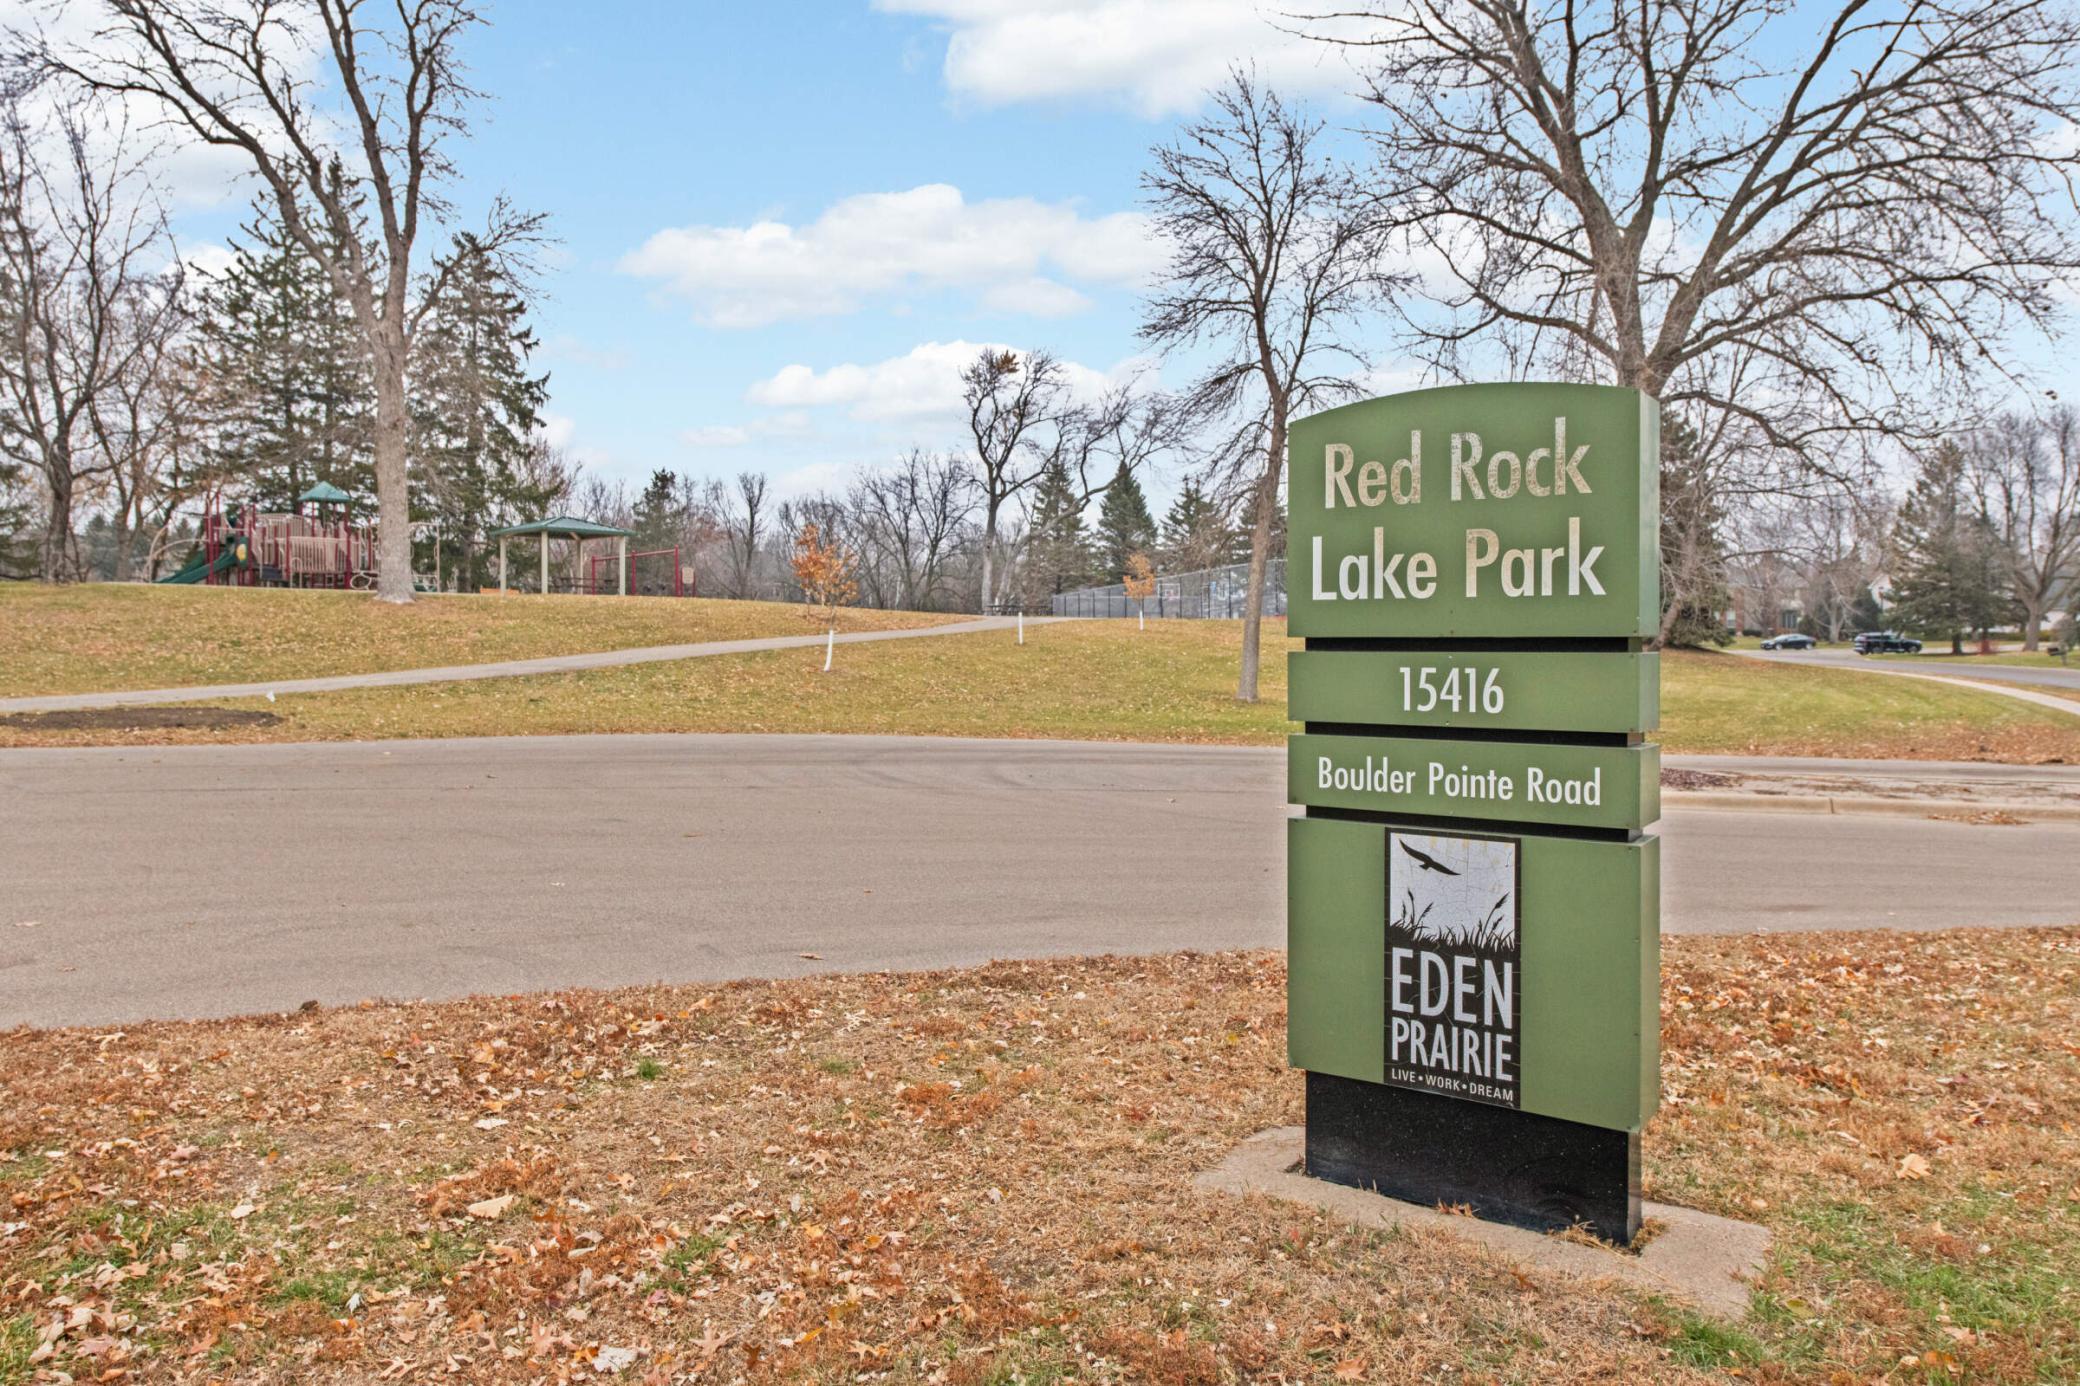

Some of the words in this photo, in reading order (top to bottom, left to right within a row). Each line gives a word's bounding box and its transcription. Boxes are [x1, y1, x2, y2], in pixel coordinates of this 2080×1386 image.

[1325, 430, 1421, 509] Red
[1451, 417, 1592, 501] Rock
[1312, 527, 1437, 600] Lake
[1465, 517, 1606, 598] Park
[1399, 667, 1505, 714] 15416
[1318, 756, 1416, 794] Boulder
[1428, 762, 1513, 800] Pointe
[1527, 767, 1601, 806] Road
[1392, 947, 1513, 1029] EDEN
[1391, 1016, 1513, 1081] PRAIRIE
